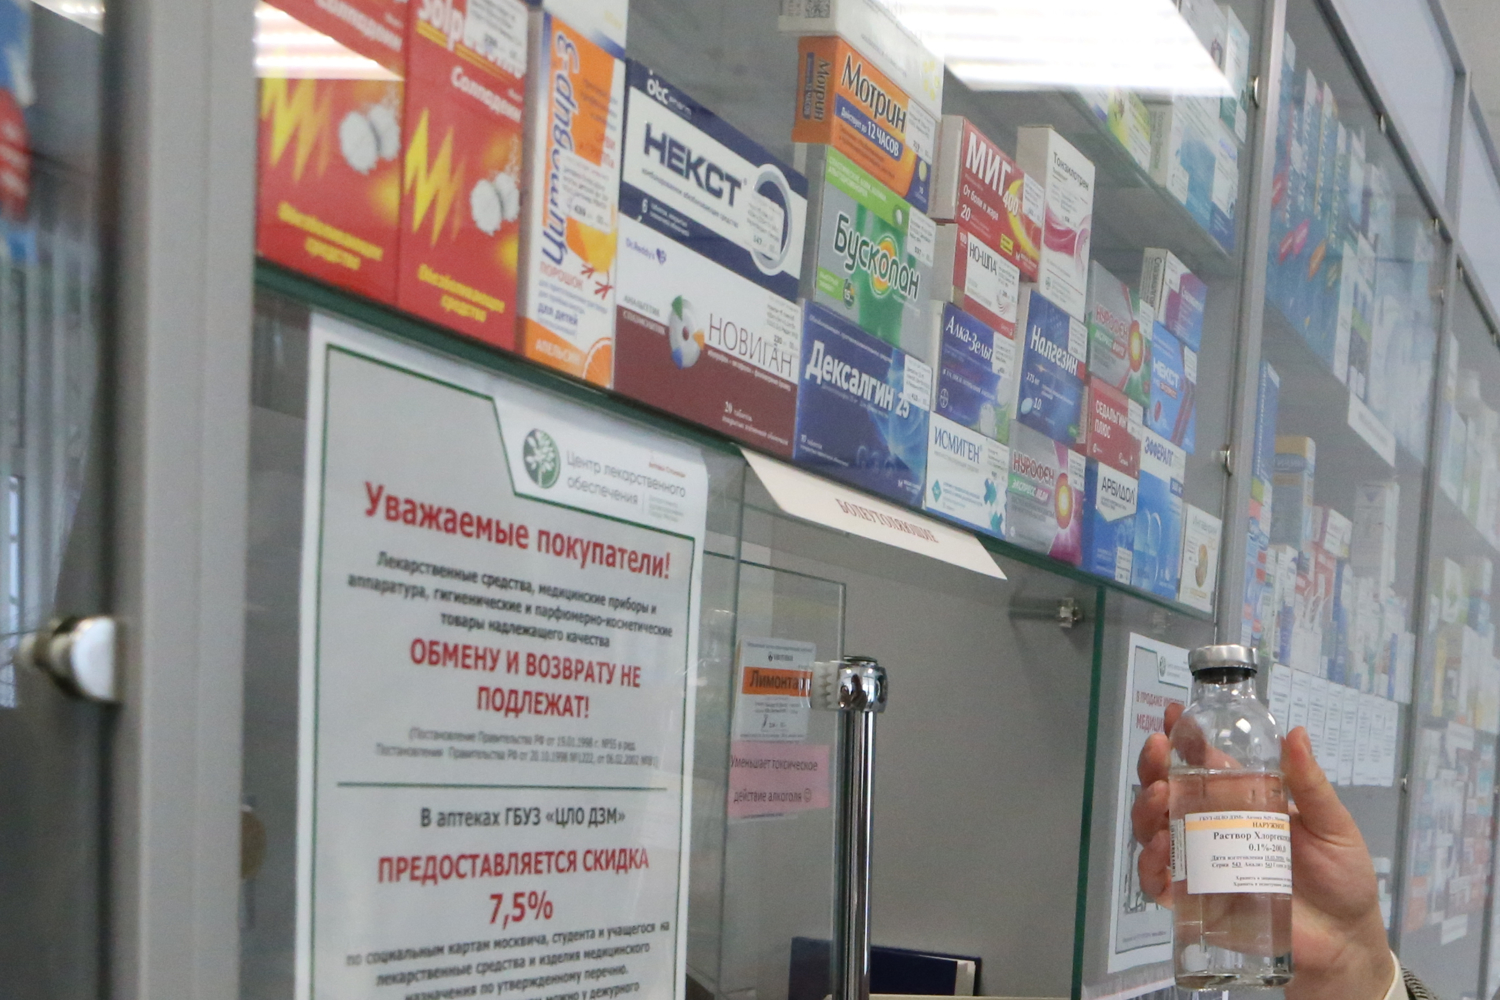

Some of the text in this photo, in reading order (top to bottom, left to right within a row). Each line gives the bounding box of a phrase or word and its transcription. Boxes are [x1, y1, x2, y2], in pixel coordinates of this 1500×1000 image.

[814, 59, 831, 121] Мотрин
[842, 55, 906, 133] Мотрин
[867, 121, 875, 140] 12
[876, 129, 899, 156] ЧАСОВ
[644, 122, 741, 207] НЕКСТ
[966, 132, 1011, 195] МИГ
[961, 204, 970, 221] 20
[963, 184, 970, 196] От
[971, 193, 982, 206] боли
[988, 205, 999, 221] жара
[1003, 192, 1018, 216] 400
[834, 212, 920, 300] Бускопан
[970, 242, 997, 275] НО-ШПА
[1031, 325, 1077, 376] Налгезин
[725, 401, 733, 414] 20
[1034, 398, 1041, 410] 10
[934, 427, 980, 464] ИСМИГЕН
[1095, 420, 1111, 439] ПЛЮС
[567, 450, 601, 474] Центр
[604, 465, 686, 497] лекарственного
[1013, 453, 1054, 486] НУРОФЕН
[568, 476, 638, 504] обеспечения
[1101, 477, 1134, 505] АРБИДОЛ
[365, 481, 670, 579] Уважаемые покупатели!
[377, 551, 657, 615] Лекарственные средства, медицинские приборы и
[434, 588, 522, 613] гигиенические
[525, 604, 532, 613] и
[535, 605, 672, 637] парфюмерно-косметические
[441, 612, 610, 648] товары надлежащего качества
[410, 638, 641, 688] ОБМЕНУ И ВОЗВРАТУ НЕ
[477, 686, 590, 719] ПОДЛЕЖАТ!
[730, 754, 770, 769] Уменьшает
[768, 791, 801, 803] алкоголя
[421, 808, 625, 829] В аптеках ГБУЗ «ЦЛО ДЗМ»
[1214, 832, 1251, 841] Раствор
[378, 847, 649, 886] ПРЕДОСТАВЛЯЕТСЯ СКИДКА
[489, 891, 553, 929] 7,5%
[346, 921, 669, 966] по социальным картам москвича, студента и учащегося на
[376, 943, 649, 987] лекарственные средства и изделия медицинского
[480, 983, 494, 994] по
[497, 971, 582, 995] утвержденному
[584, 965, 628, 981] перечню.
[590, 982, 640, 1000] дежурного
